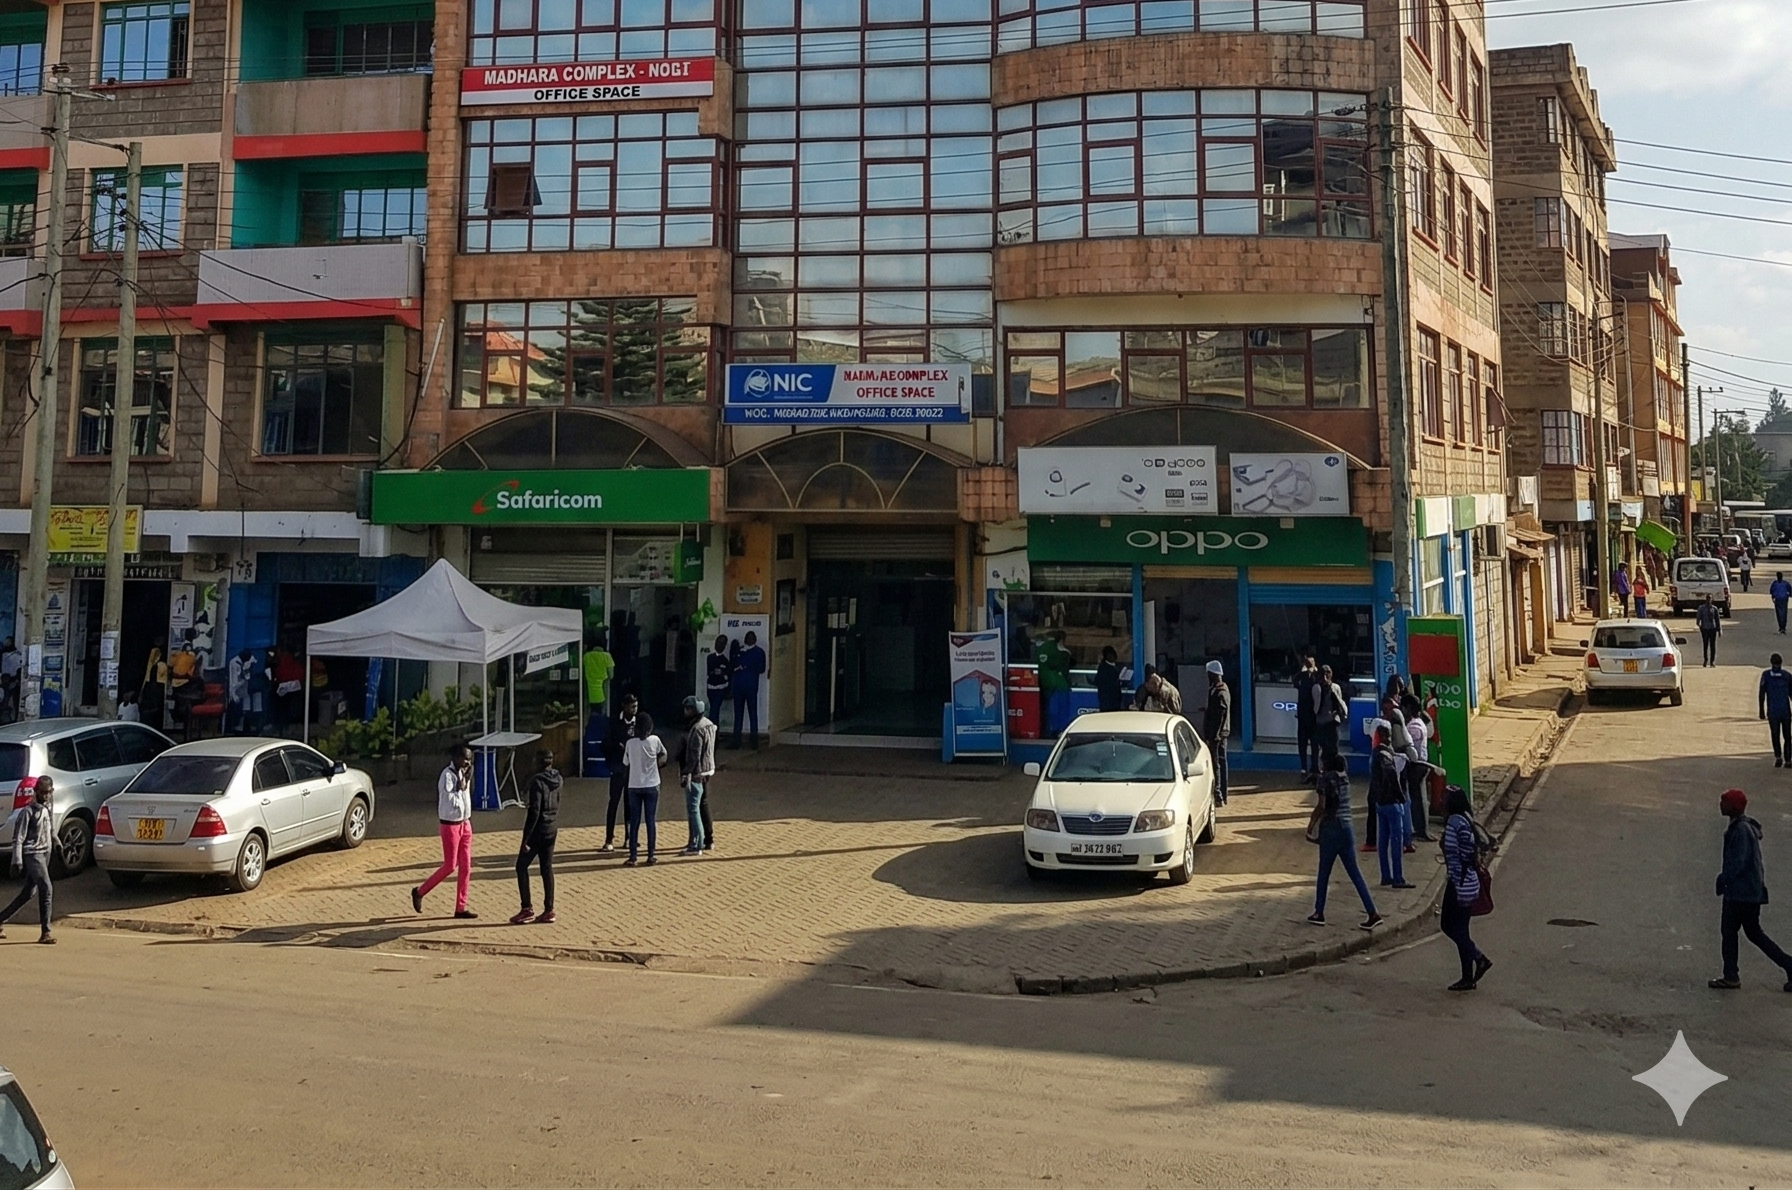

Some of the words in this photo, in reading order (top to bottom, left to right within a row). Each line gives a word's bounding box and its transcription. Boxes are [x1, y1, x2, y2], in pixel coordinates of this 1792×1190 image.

[484, 67, 559, 85] MADHARA
[563, 63, 636, 82] COMPLEX
[534, 88, 588, 101] OFFICE
[592, 86, 641, 99] SPACE
[773, 373, 813, 392] NIC
[856, 387, 898, 398] OFFICE
[901, 387, 935, 398] SPACE
[496, 489, 602, 509] Safaricom
[1126, 530, 1269, 555] oppo
